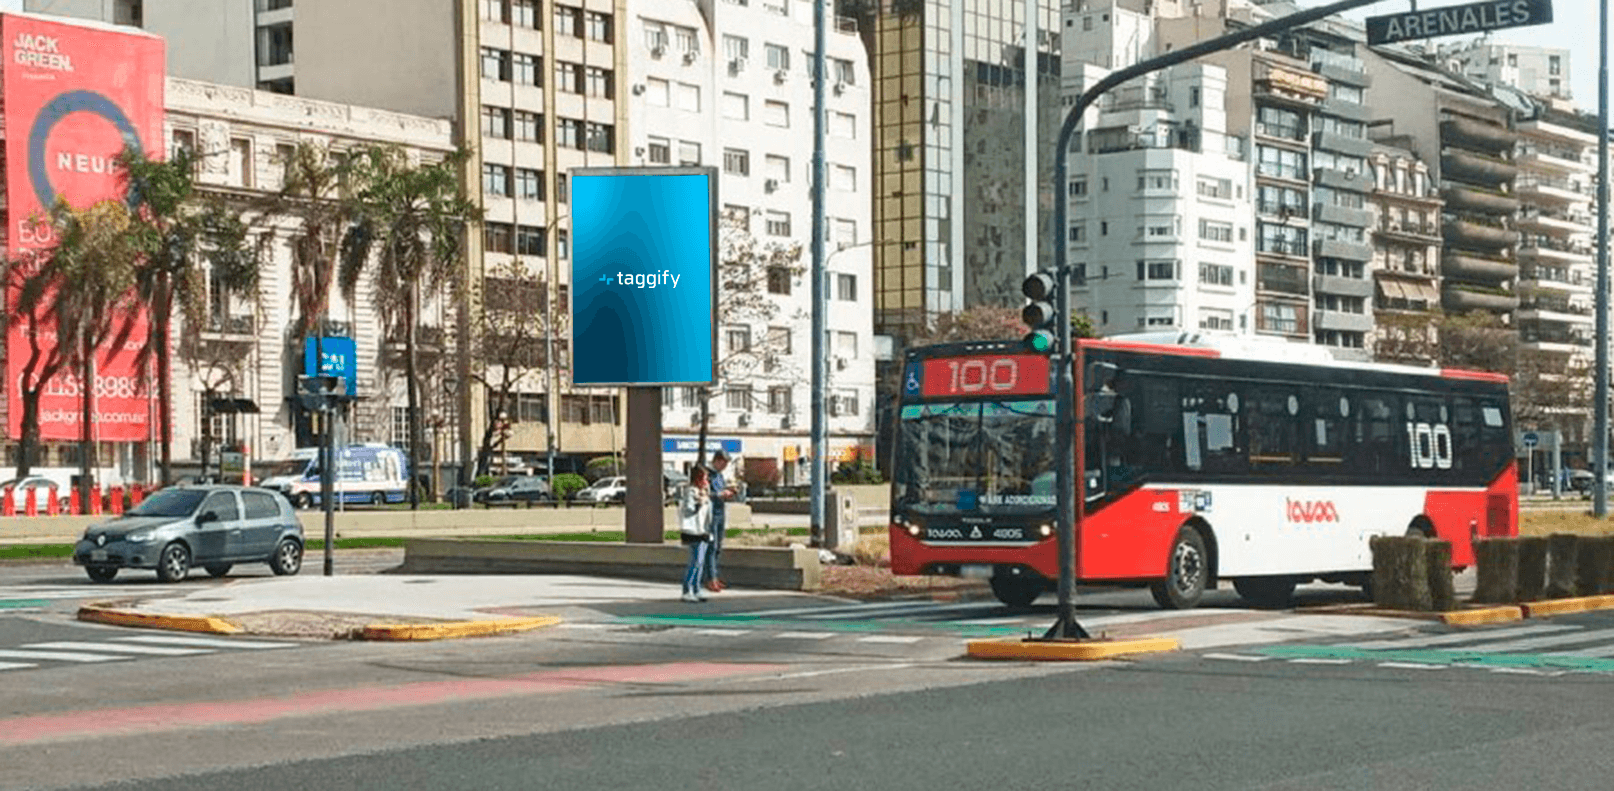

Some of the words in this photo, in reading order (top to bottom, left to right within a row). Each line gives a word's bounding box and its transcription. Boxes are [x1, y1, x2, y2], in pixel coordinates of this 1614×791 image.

[1385, 1, 1530, 40] ARENALES
[14, 33, 58, 53] JACK
[617, 269, 681, 289] taggify
[948, 358, 1018, 393] 100
[1406, 421, 1453, 469] 100
